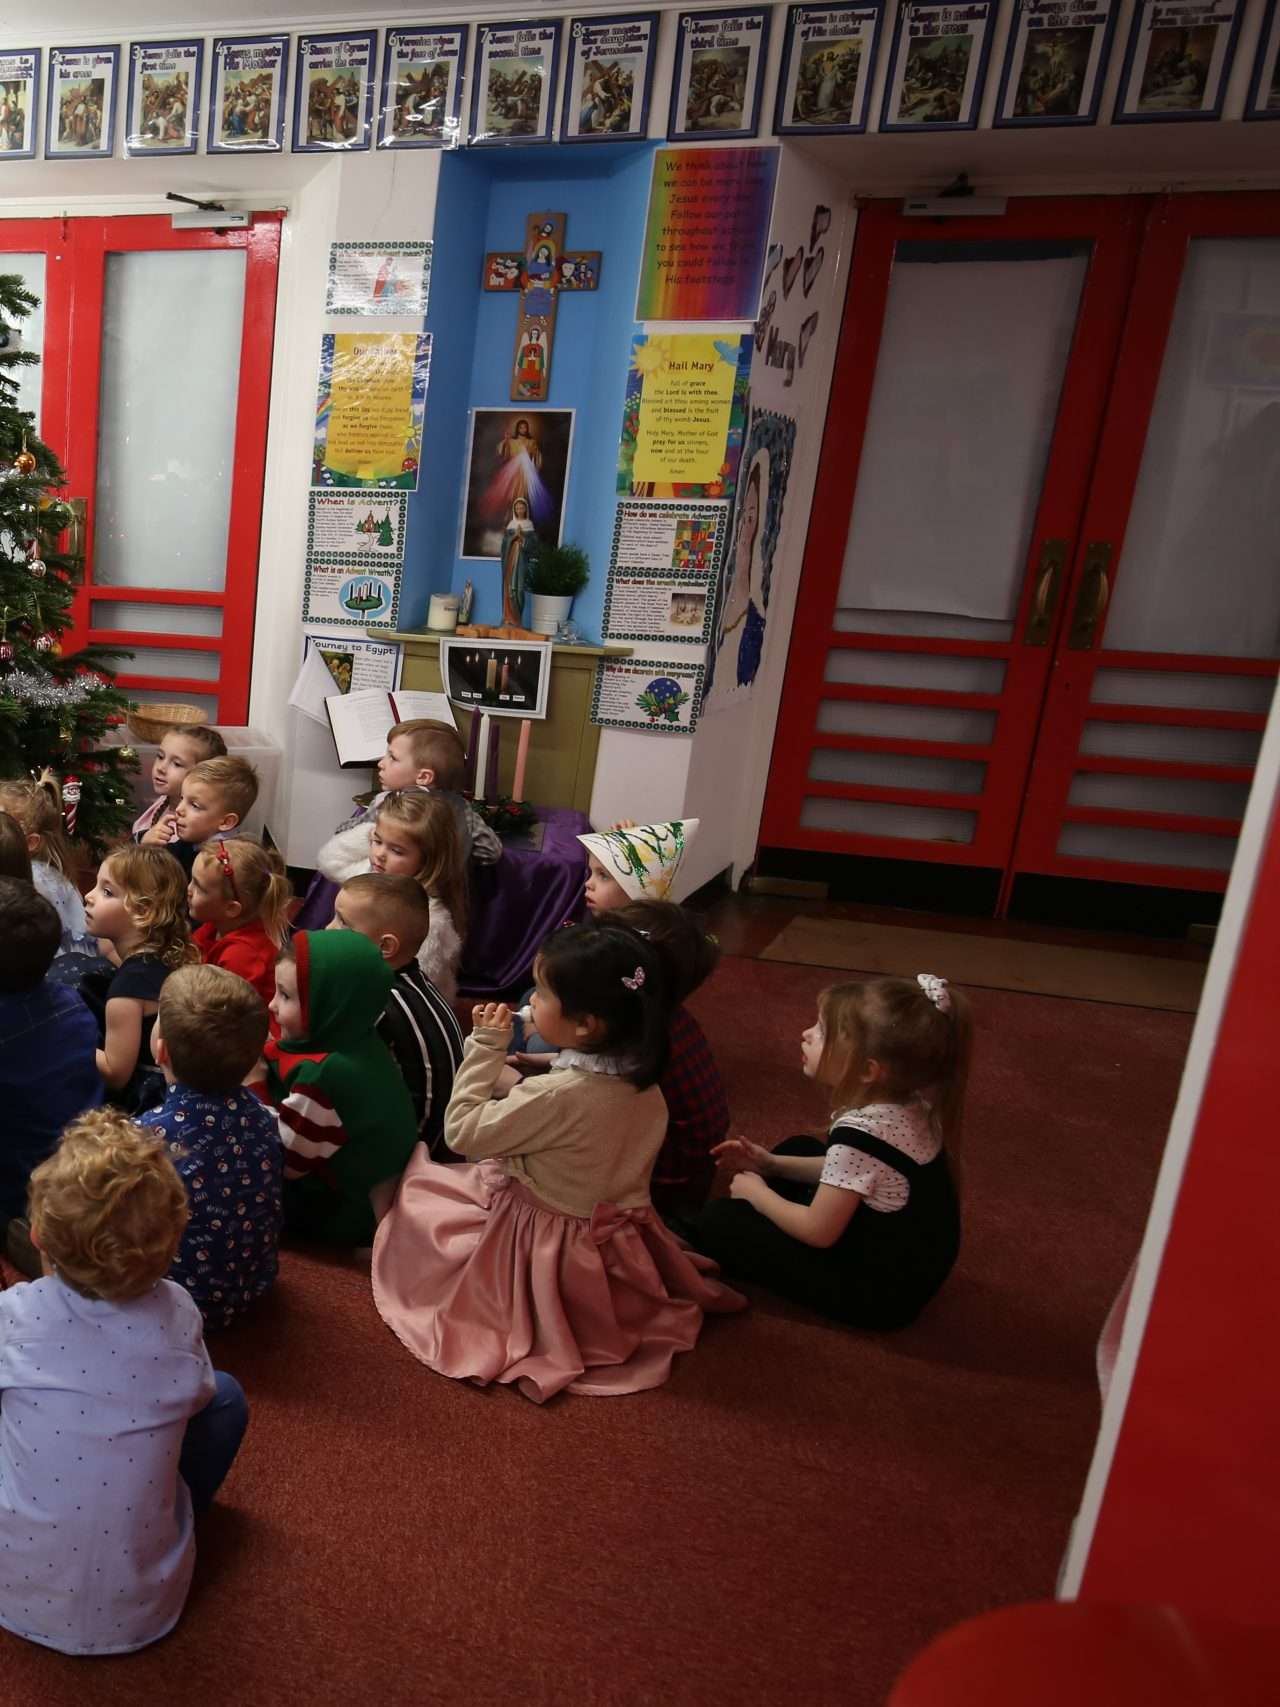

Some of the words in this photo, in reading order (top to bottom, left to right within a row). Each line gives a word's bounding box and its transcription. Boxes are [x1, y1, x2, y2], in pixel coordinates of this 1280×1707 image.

[792, 8, 802, 24] 10
[803, 13, 827, 24] Jesus
[829, 13, 837, 24] is
[838, 9, 875, 26] stripped
[913, 9, 939, 23] Jesus
[942, 8, 951, 19] is
[953, 5, 987, 20] nailed
[1072, 14, 1106, 25] cross
[573, 23, 582, 38] 8
[582, 26, 610, 38] Jesus
[612, 25, 640, 34] meets
[682, 17, 692, 33] 9
[692, 22, 719, 34] Jesus
[721, 20, 743, 37] falls
[746, 18, 761, 30] the
[909, 25, 919, 36] to
[923, 23, 940, 35] the
[941, 24, 968, 34] cross
[389, 31, 397, 47] 6
[480, 28, 489, 43] 7
[489, 34, 514, 45] Jesus
[515, 30, 536, 48] falls
[539, 30, 553, 41] the
[582, 35, 597, 45] the
[600, 32, 648, 46] daughters
[801, 28, 811, 42] of
[812, 26, 827, 37] His
[829, 25, 860, 36] clothes
[216, 41, 224, 56] 4
[300, 40, 310, 54] 5
[398, 37, 431, 47] Veronica
[433, 36, 454, 48] wipes
[691, 36, 714, 49] third
[717, 36, 739, 47] time
[132, 46, 141, 60] 3
[142, 50, 162, 60] Jesus
[164, 49, 182, 62] falls
[183, 49, 196, 58] the
[224, 47, 251, 57] Jesus
[253, 46, 281, 57] meets
[309, 45, 332, 55] Simon
[334, 43, 343, 58] of
[344, 42, 368, 56] Cyrene
[397, 50, 409, 59] the
[409, 49, 426, 61] face
[428, 48, 437, 59] of
[437, 48, 458, 57] Jesus
[488, 48, 519, 59] second
[521, 47, 541, 57] time
[581, 49, 592, 60] of
[593, 44, 643, 56] Jerusalem
[51, 50, 61, 64] 2
[60, 55, 81, 66] Jesus
[83, 55, 90, 65] is
[92, 55, 112, 68] given
[224, 57, 239, 70] His
[242, 57, 277, 70] Mother
[309, 60, 332, 69] carries
[335, 58, 346, 67] the
[349, 58, 367, 66] cross
[73, 70, 92, 78] cross
[141, 62, 157, 74] first
[159, 62, 176, 70] time
[666, 160, 681, 171] We
[669, 194, 698, 203] Jesus
[670, 210, 701, 220] Follow
[766, 325, 796, 387] Mary
[669, 361, 688, 370] Hail
[691, 361, 714, 372] Mary
[659, 512, 690, 520] celebrate
[313, 565, 329, 573] What
[368, 568, 394, 577] Wreath?
[313, 640, 348, 651] ourney
[352, 642, 362, 651] to
[605, 665, 616, 673] Why
[632, 667, 654, 675] decorate
